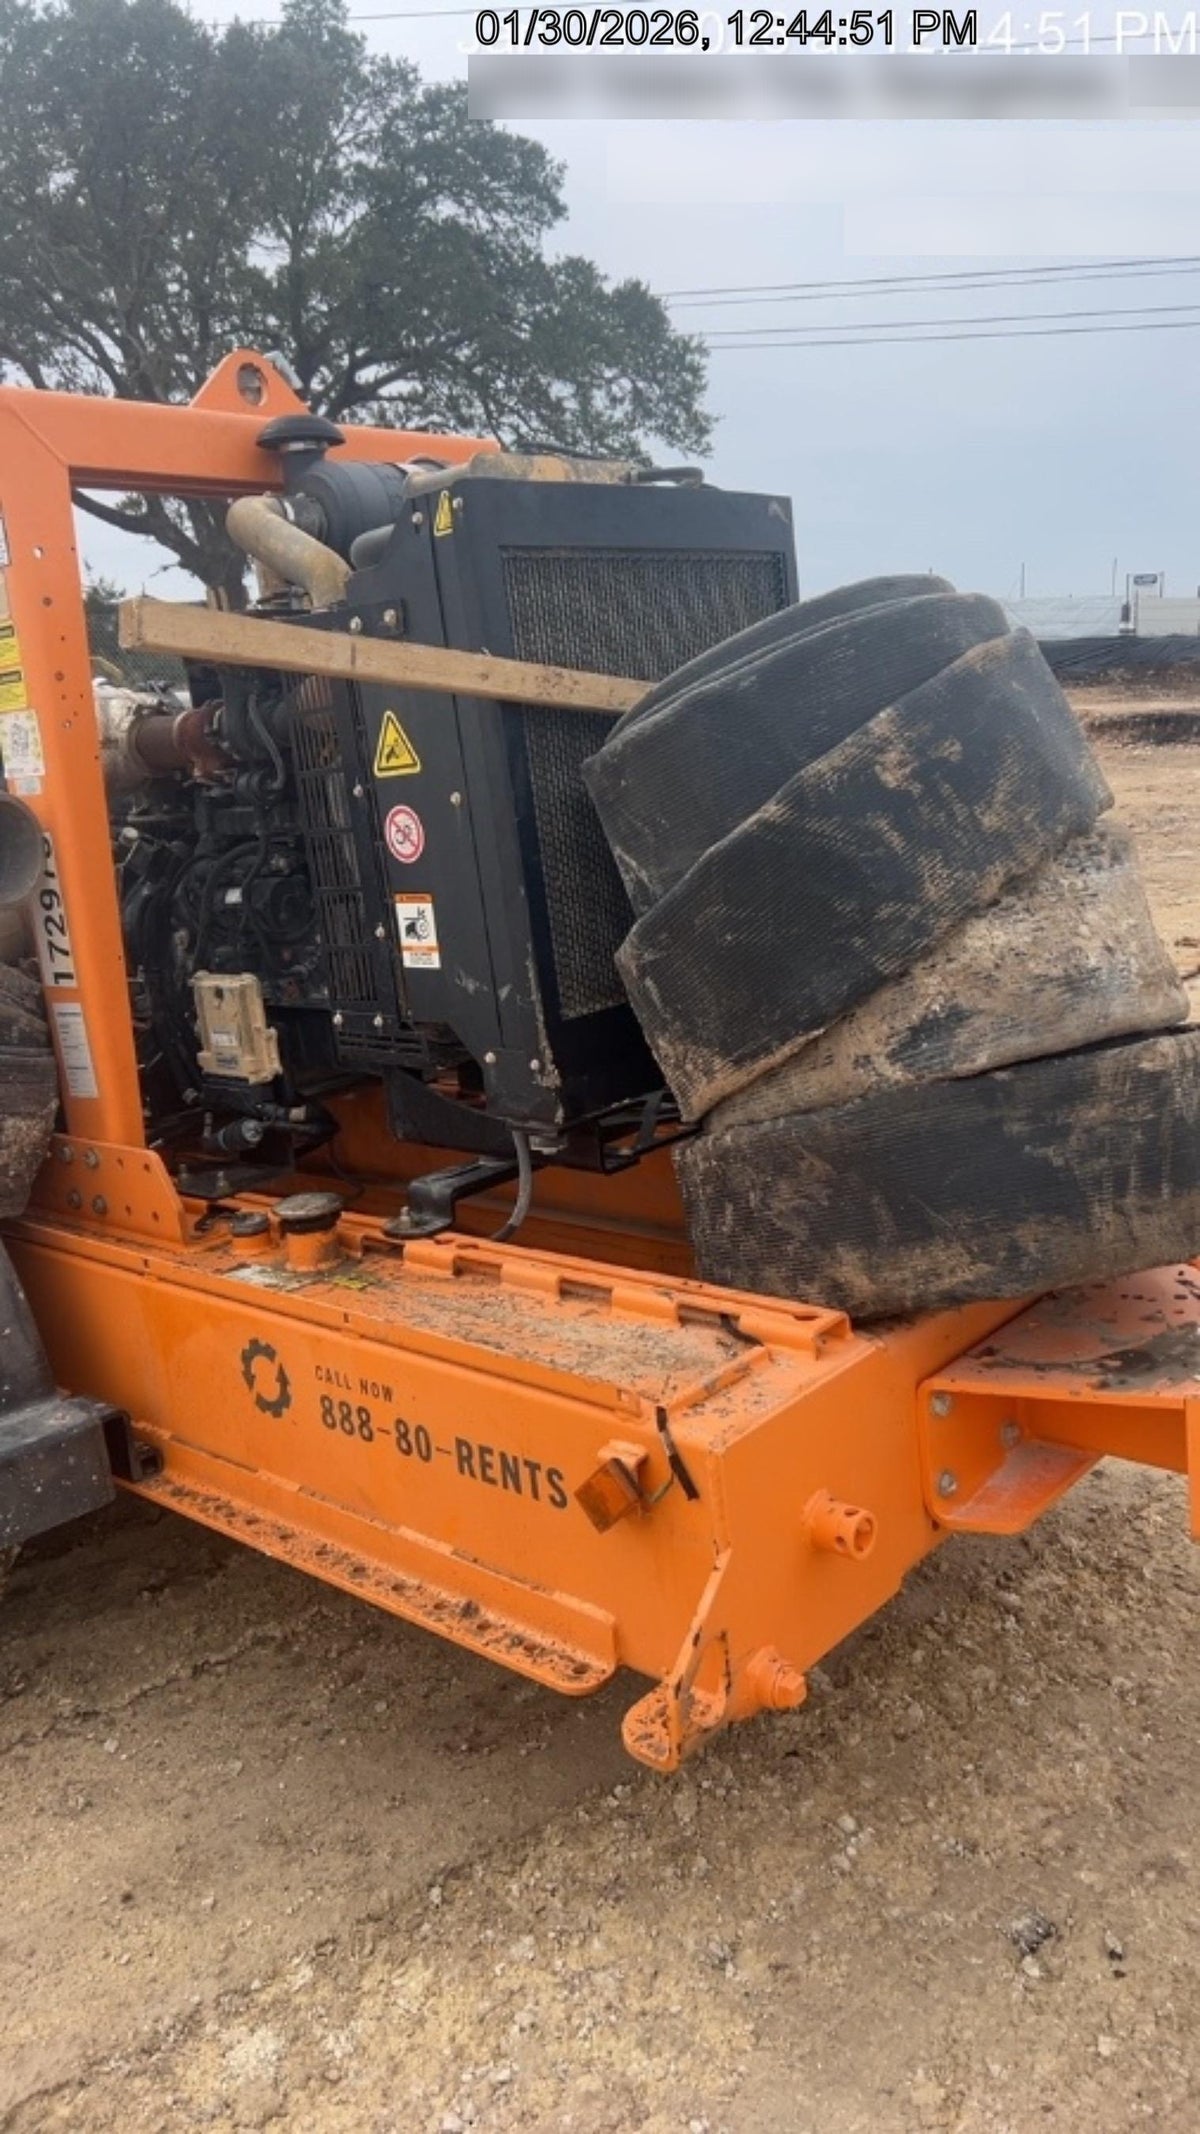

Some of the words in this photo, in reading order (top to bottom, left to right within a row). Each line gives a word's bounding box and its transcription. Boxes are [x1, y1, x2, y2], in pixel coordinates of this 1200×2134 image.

[315, 1365, 353, 1391] CALL
[359, 1378, 394, 1403] NOW
[320, 1394, 568, 1509] 888-80-RENTS
